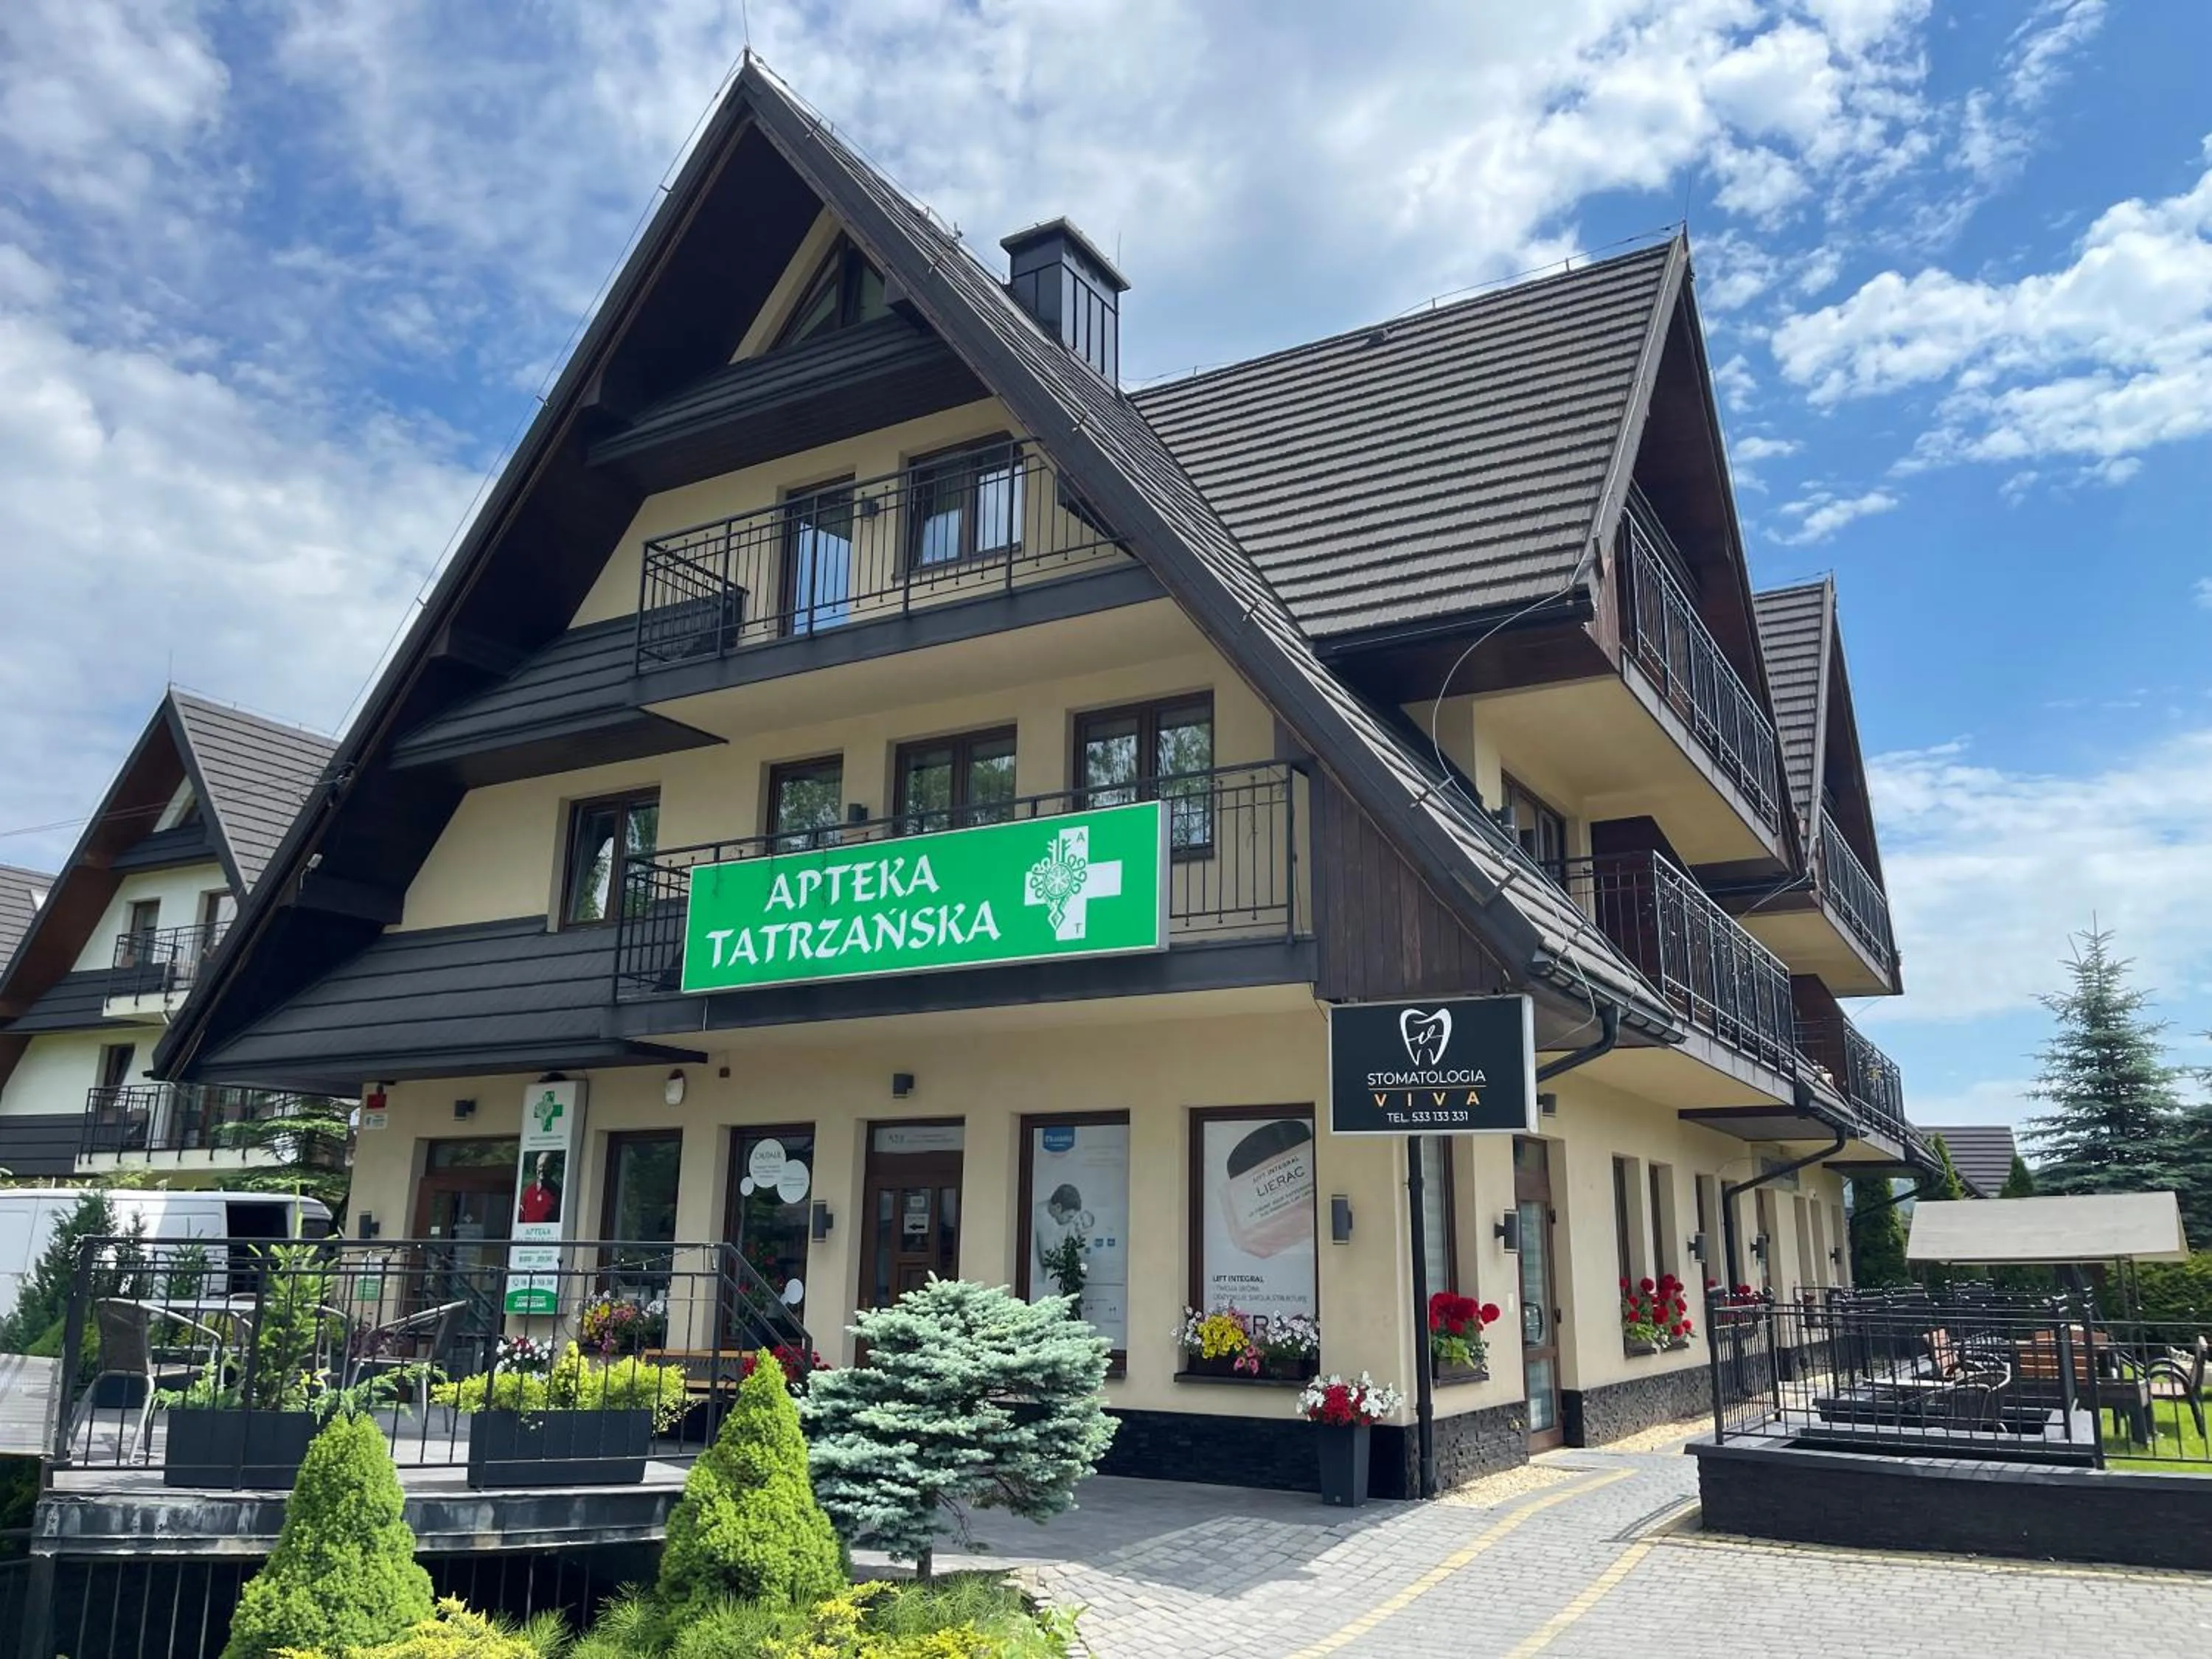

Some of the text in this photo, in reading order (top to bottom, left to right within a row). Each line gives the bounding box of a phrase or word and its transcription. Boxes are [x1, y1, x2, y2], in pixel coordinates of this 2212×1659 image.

[1076, 831, 1085, 843] A
[764, 854, 940, 913] APTEKA
[706, 900, 1002, 968] TATRZAŃSKA
[1074, 922, 1082, 933] T
[1368, 1069, 1486, 1086] STOMATOLOGIA
[1411, 1111, 1430, 1122] 533
[1433, 1110, 1450, 1122] 133
[1452, 1110, 1469, 1121] 331
[1256, 1166, 1306, 1197] LIERAC
[1228, 1275, 1265, 1284] INTEGRAL
